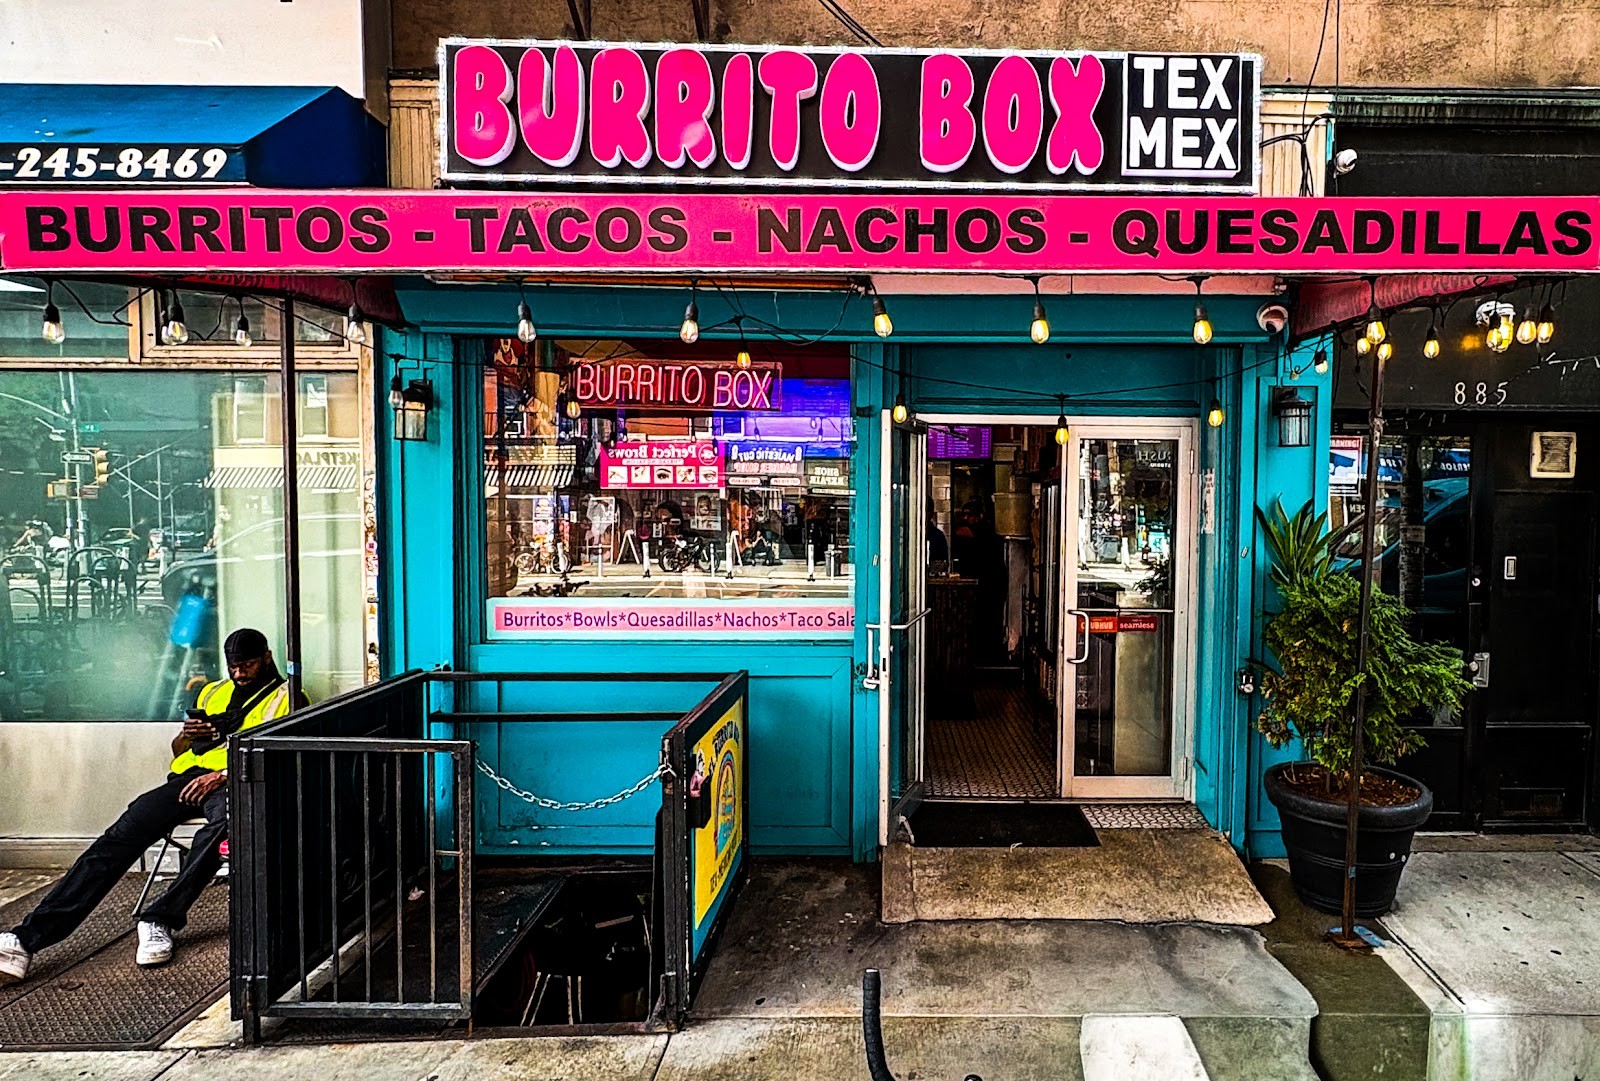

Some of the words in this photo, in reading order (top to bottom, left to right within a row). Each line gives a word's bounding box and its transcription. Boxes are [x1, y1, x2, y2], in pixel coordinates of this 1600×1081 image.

[1133, 56, 1233, 110] TEX
[453, 44, 881, 172] BURRITO
[919, 53, 1106, 175] BOX
[0, 148, 227, 179] -245-8469
[1129, 116, 1238, 170] MEX
[26, 206, 391, 253] BURRITOS
[414, 229, 435, 242] -
[455, 206, 688, 253] TACOS
[713, 231, 733, 242] -
[757, 207, 1047, 253] NACHOS
[1069, 232, 1089, 243] -
[1113, 208, 1593, 258] QUESADILLAS
[576, 363, 703, 404] BURRITO
[713, 370, 771, 408] BOX
[1120, 621, 1155, 629] seamless
